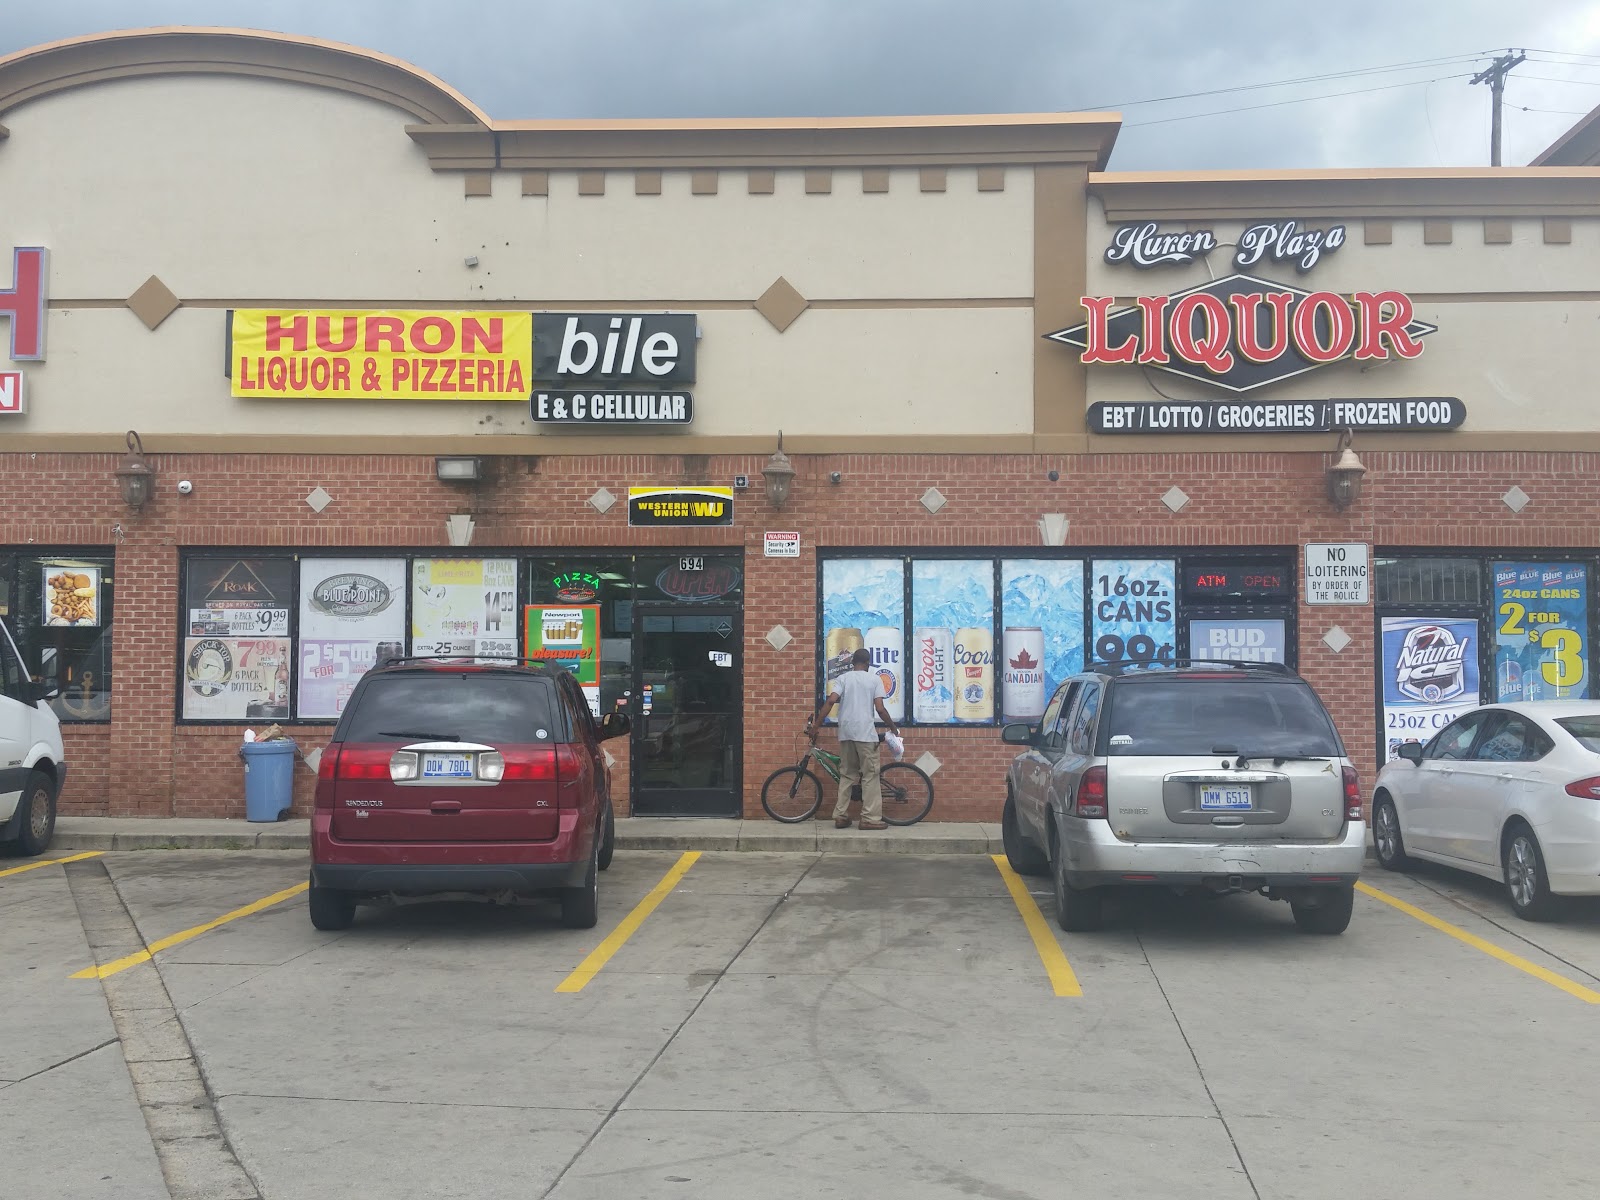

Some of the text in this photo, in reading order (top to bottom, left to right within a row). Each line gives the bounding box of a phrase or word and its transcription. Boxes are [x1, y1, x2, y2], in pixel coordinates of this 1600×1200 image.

[1107, 221, 1345, 270] Huron Plaza
[265, 315, 503, 354] HURON
[1080, 291, 1424, 374] LIQUOR
[557, 317, 679, 375] bile
[240, 356, 525, 393] LIQUOR & PIZZERIA
[537, 394, 686, 420] E & C CELLULAR
[1102, 406, 1136, 428] EBT
[1149, 406, 1203, 428] LOTTO
[1217, 405, 1316, 427] GROCERIES
[1335, 402, 1401, 425] FROZEN
[1406, 402, 1452, 424] FOOD
[638, 502, 688, 510] WESTERN
[653, 509, 688, 517] UNION
[1327, 547, 1346, 561] NO
[680, 557, 703, 570] 694
[1307, 565, 1367, 577] LOITERING
[553, 572, 599, 589] PIZZA
[1197, 576, 1280, 587] ATM OPEN
[1312, 581, 1362, 589] BY ORDER OF
[323, 589, 382, 602] BLUE POINT
[1316, 592, 1360, 600] THE POLICE
[1540, 588, 1580, 599] CANS
[239, 611, 253, 621] PACK
[1097, 601, 1172, 623] CANS
[1499, 602, 1560, 635] 2 FOR
[231, 621, 255, 631] BOTTLES
[1209, 629, 1266, 647] BUD
[193, 640, 231, 662] SHOCK TOP
[434, 642, 452, 654] 25
[531, 646, 592, 660] pleasure!
[1396, 637, 1469, 669] Natural
[713, 653, 728, 662] EBT
[1200, 648, 1276, 663] LIGHT
[917, 637, 935, 692] Coors
[935, 647, 944, 682] LIGHT
[241, 670, 259, 679] PACK
[314, 665, 334, 678] FOR
[1396, 661, 1462, 682] ICE
[1004, 673, 1043, 684] CANADIAN
[231, 682, 263, 692] BOTTLES
[427, 760, 470, 772] DQW 7801
[1226, 791, 1249, 804] 6513
